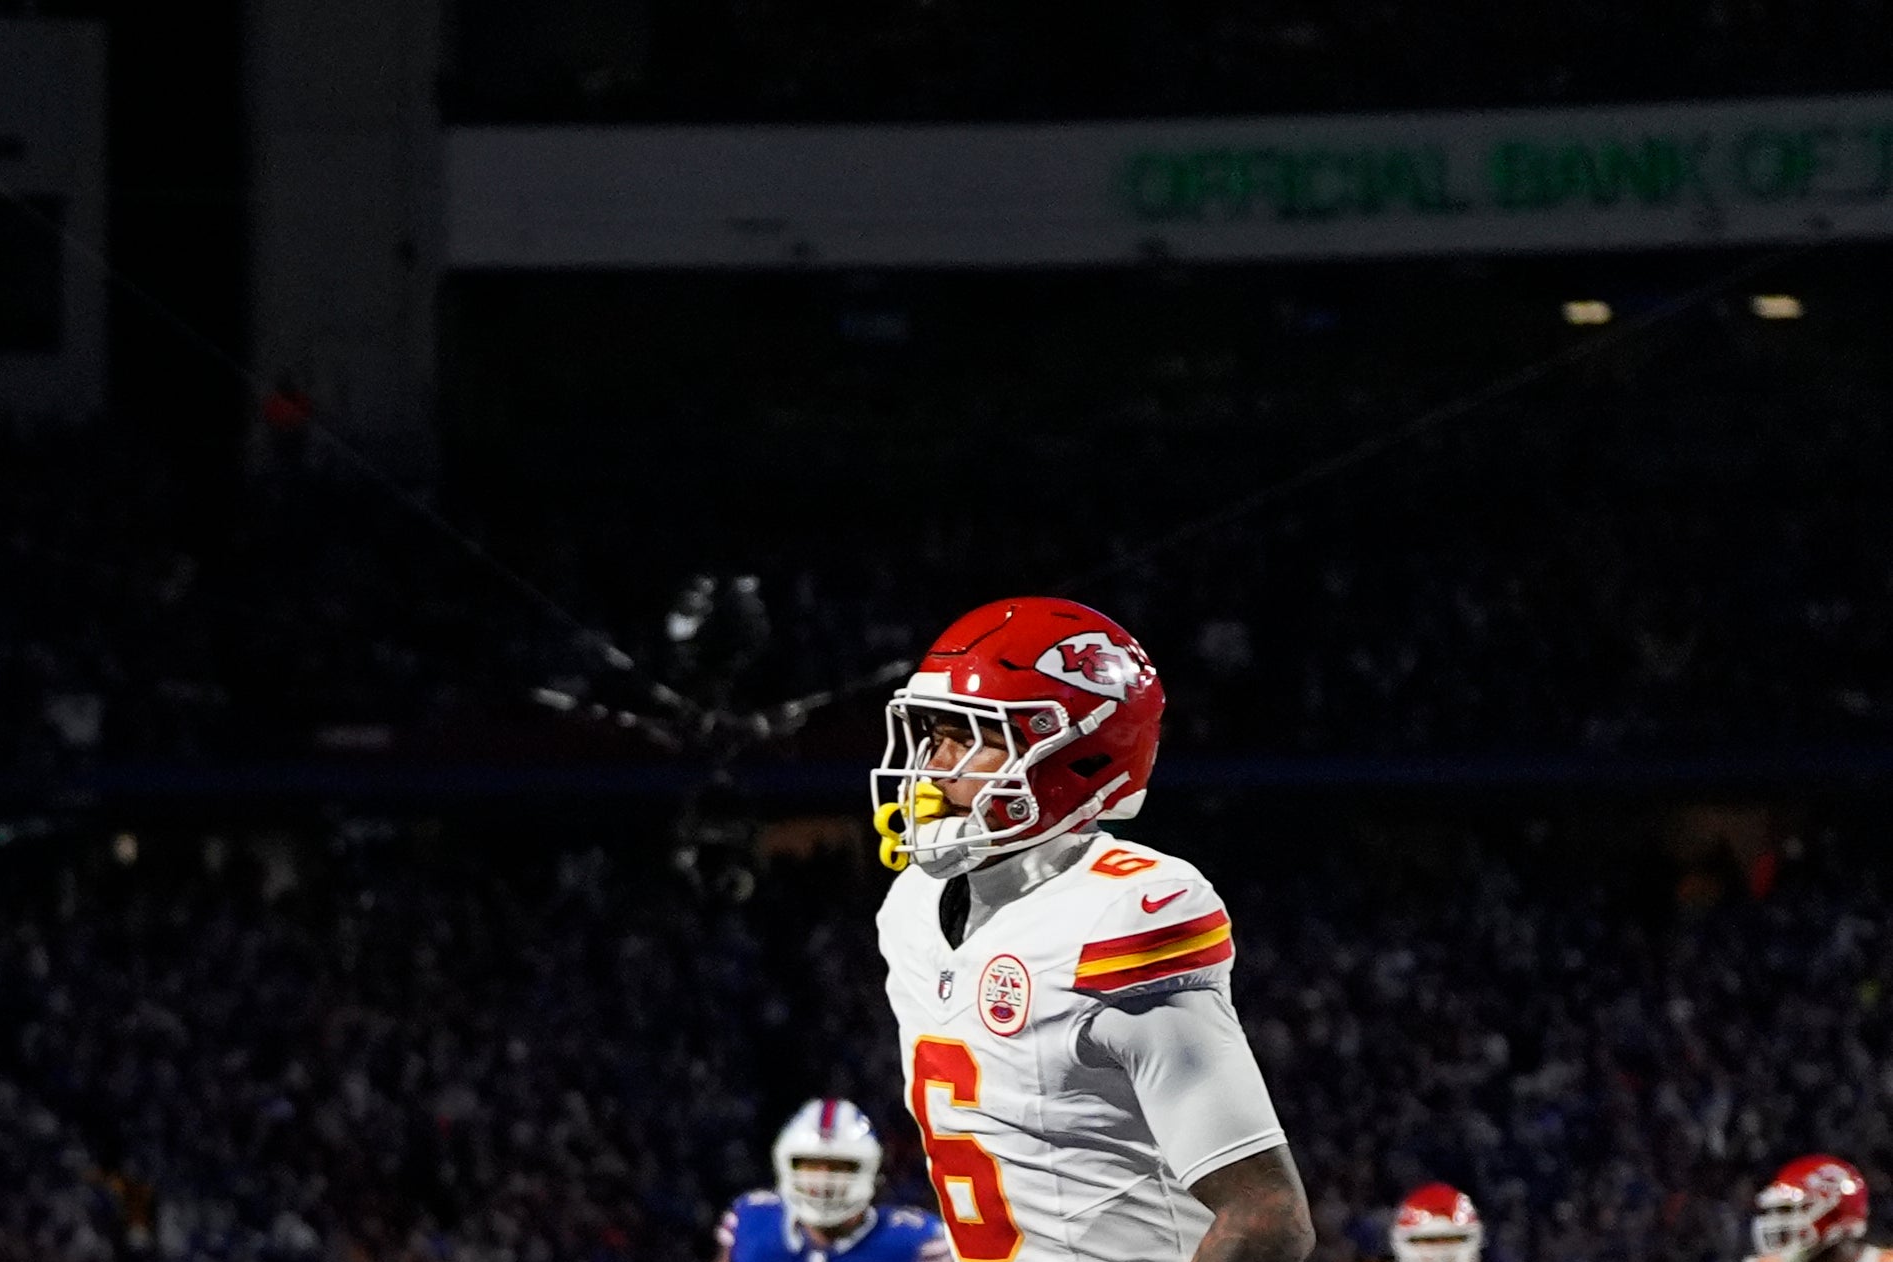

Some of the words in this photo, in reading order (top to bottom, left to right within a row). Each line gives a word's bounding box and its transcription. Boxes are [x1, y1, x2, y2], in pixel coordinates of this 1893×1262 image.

[1120, 146, 1469, 221] OFFICIAL
[1487, 134, 1714, 212] BANK
[1089, 848, 1160, 879] 6
